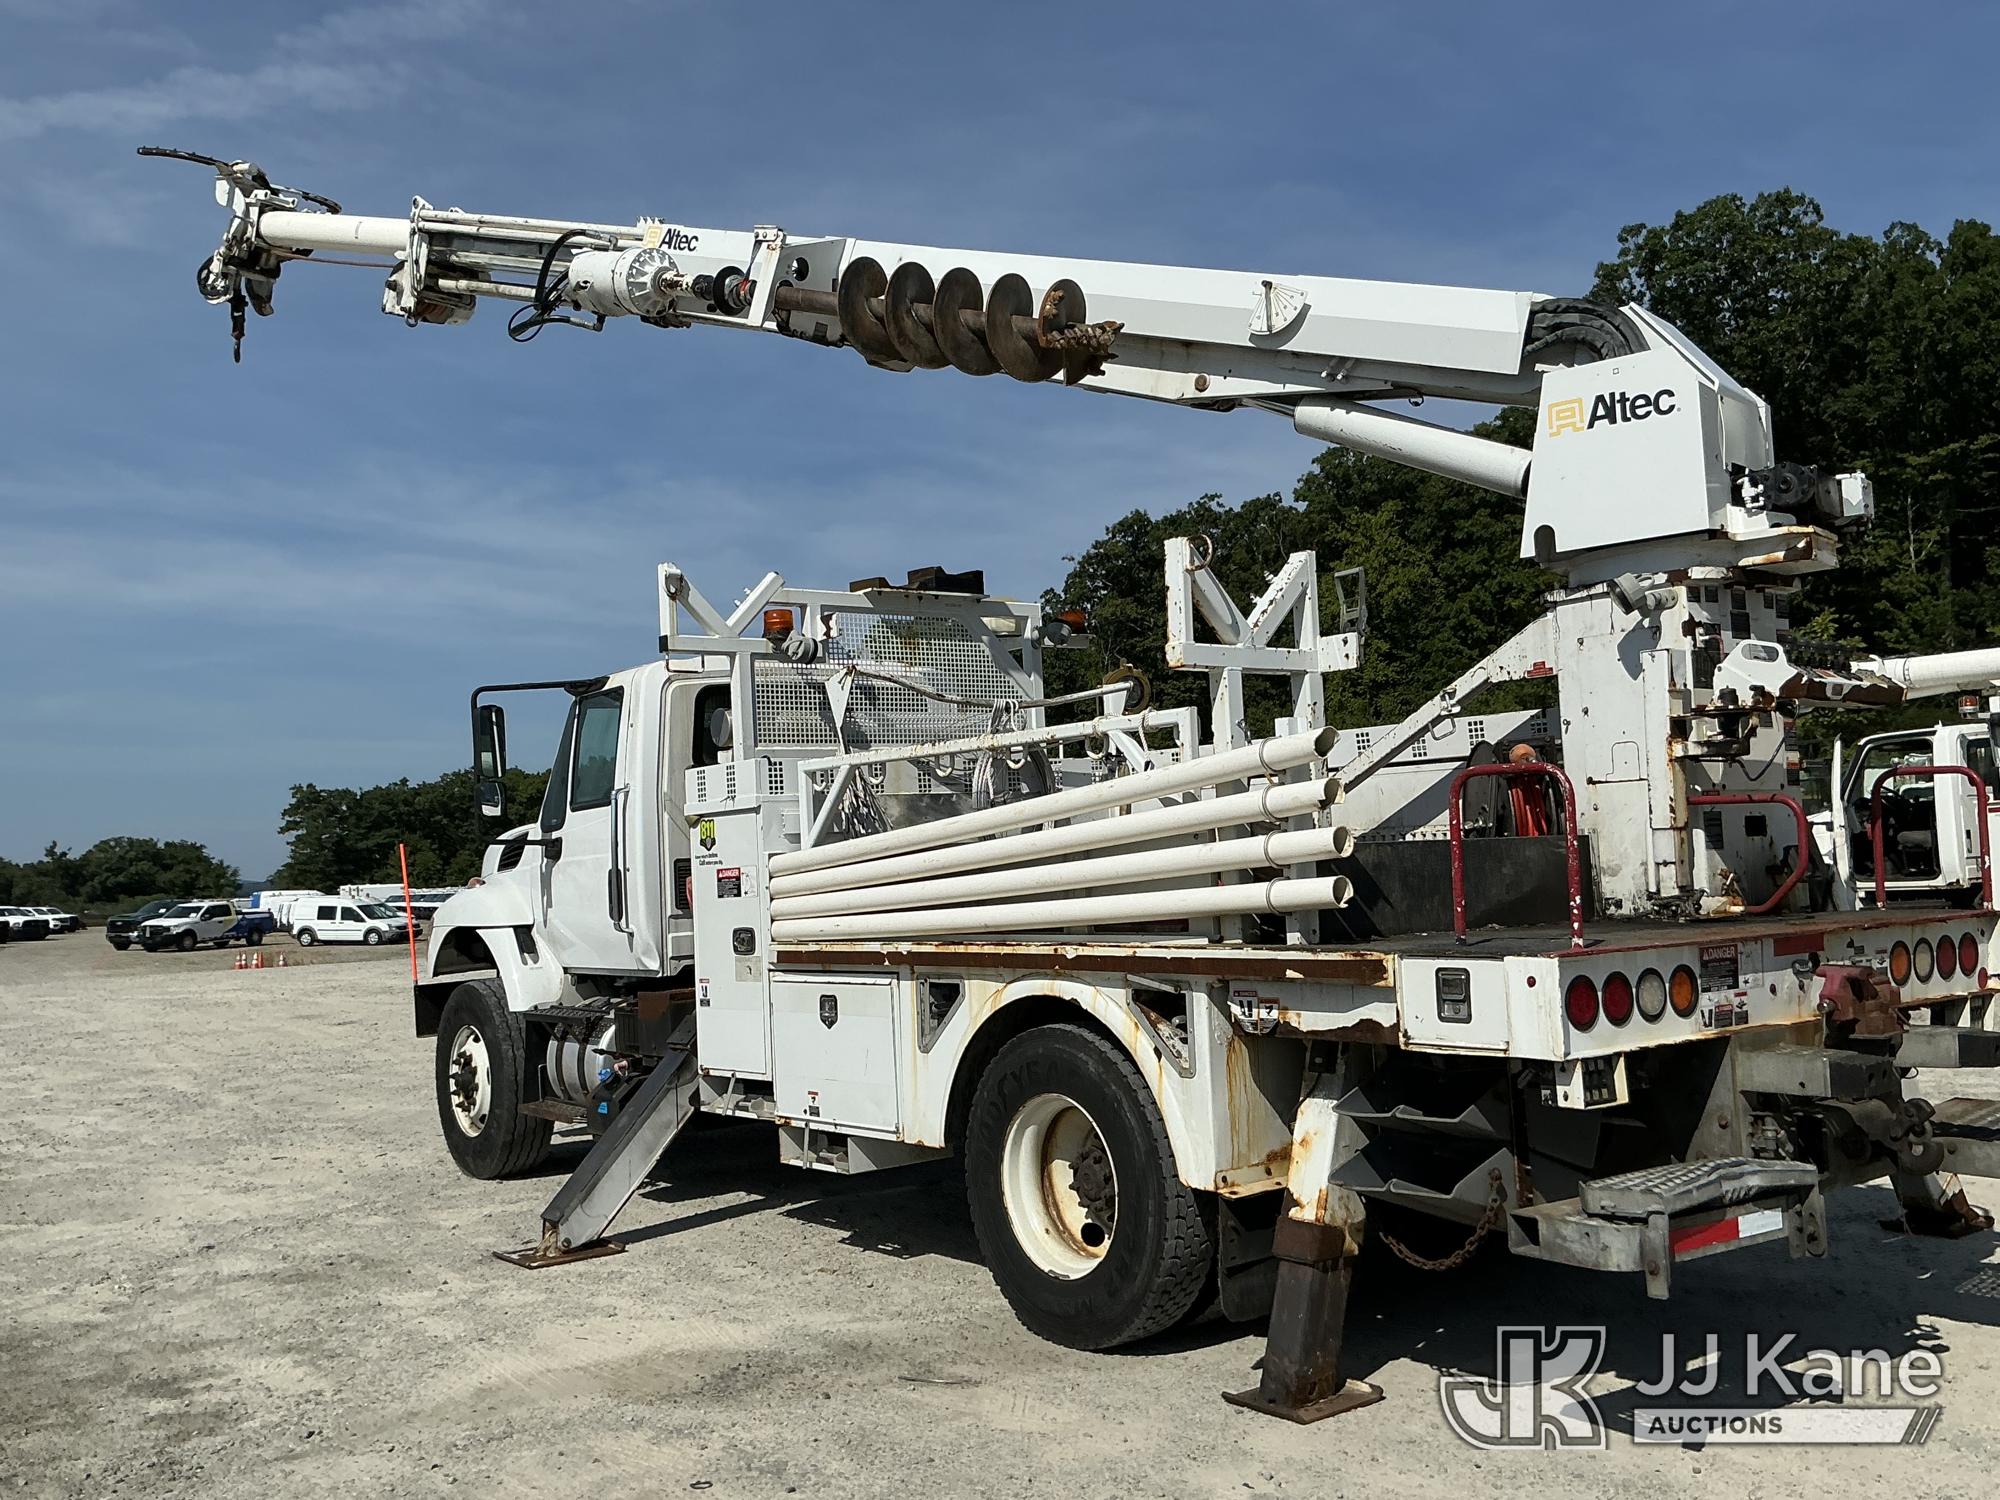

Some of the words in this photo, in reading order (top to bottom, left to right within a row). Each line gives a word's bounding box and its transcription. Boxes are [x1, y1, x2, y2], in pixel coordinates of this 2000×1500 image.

[658, 228, 699, 252] Altec
[1587, 389, 1676, 429] Altec
[701, 820, 714, 839] 811
[722, 869, 739, 877] DANGER
[1708, 946, 1735, 959] DANGER
